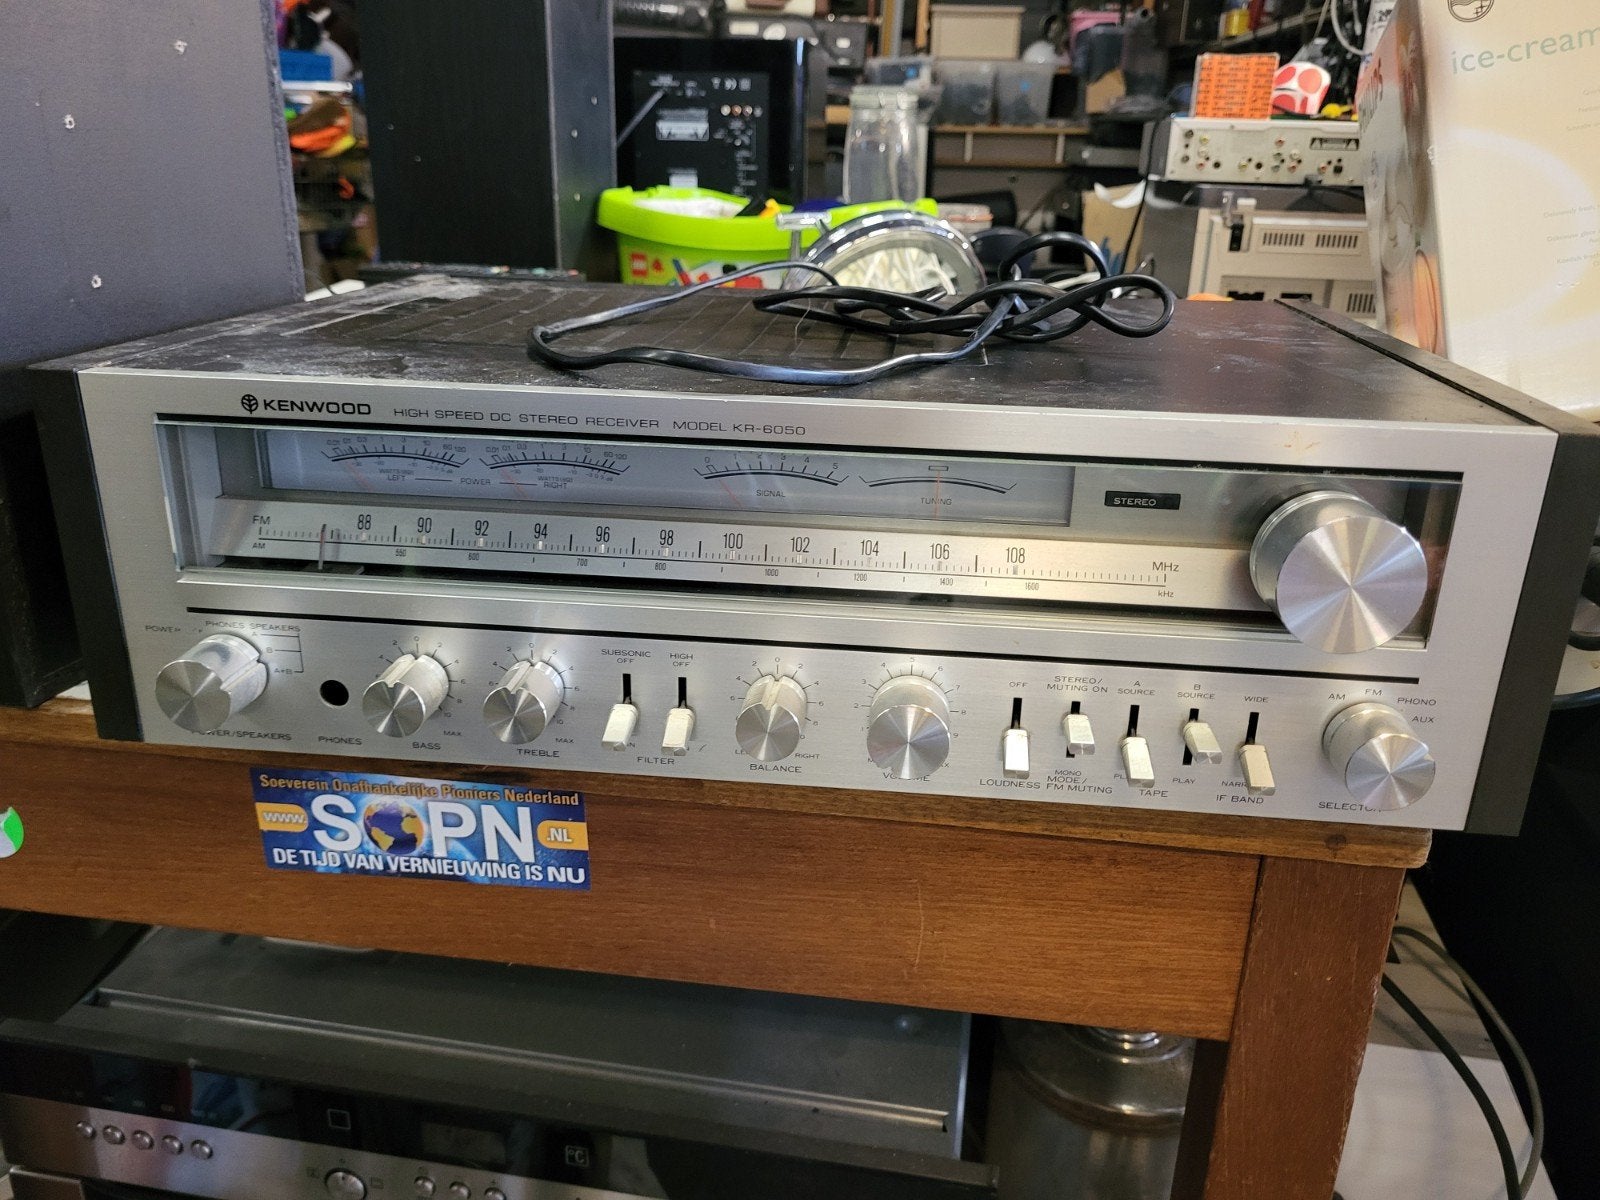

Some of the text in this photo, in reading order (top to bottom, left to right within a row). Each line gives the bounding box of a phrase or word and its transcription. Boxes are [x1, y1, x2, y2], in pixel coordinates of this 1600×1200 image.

[263, 399, 371, 415] KENWOOD
[394, 408, 806, 436] HIGH SPEED DC STEREO RECEIVER MODEL KR-6050
[756, 489, 786, 498] SIGNAL
[920, 497, 952, 506] TUNING
[1113, 497, 1157, 506] STEREO
[252, 514, 1179, 572] FM 88 90 92 94 96 98 100 102 104 106 108 MHz
[577, 558, 588, 567] 700
[655, 562, 666, 571] 800
[765, 568, 778, 577] 1000
[853, 573, 867, 581] 1200
[939, 578, 953, 586] 1400
[1025, 582, 1039, 591] 1600
[1158, 589, 1174, 598] kHz
[205, 620, 245, 629] PHONES
[249, 623, 301, 632] SPEAKERS
[601, 648, 651, 658] SUBSONIC
[1054, 675, 1103, 684] STEREO/
[1047, 683, 1088, 692] MUTING
[1117, 687, 1155, 696] SOURCE
[1365, 688, 1383, 696] FM
[1177, 691, 1215, 700] SOURCE
[1397, 697, 1437, 706] PHONO
[1412, 715, 1435, 723] AUX
[318, 735, 362, 745] PHONES
[412, 741, 441, 750] BASS
[517, 748, 560, 758] TREBLE
[637, 757, 675, 765] FILTER
[749, 763, 802, 773] BALANCE
[1054, 769, 1082, 777] MONO
[979, 778, 1040, 789] LOUDNESS
[1047, 775, 1088, 785] MODE/
[1172, 777, 1197, 785] PLAY
[259, 774, 579, 806] Soeverein Onafhankelijke Pioniers Nederland
[1046, 783, 1113, 794] FM MUTING
[1139, 789, 1169, 798] TAPE
[1216, 794, 1264, 804] IF BAND
[262, 811, 307, 825] www.
[546, 827, 573, 843] .NL
[273, 847, 585, 884] DE TIJD VAN VERNIEUWING IS NU
